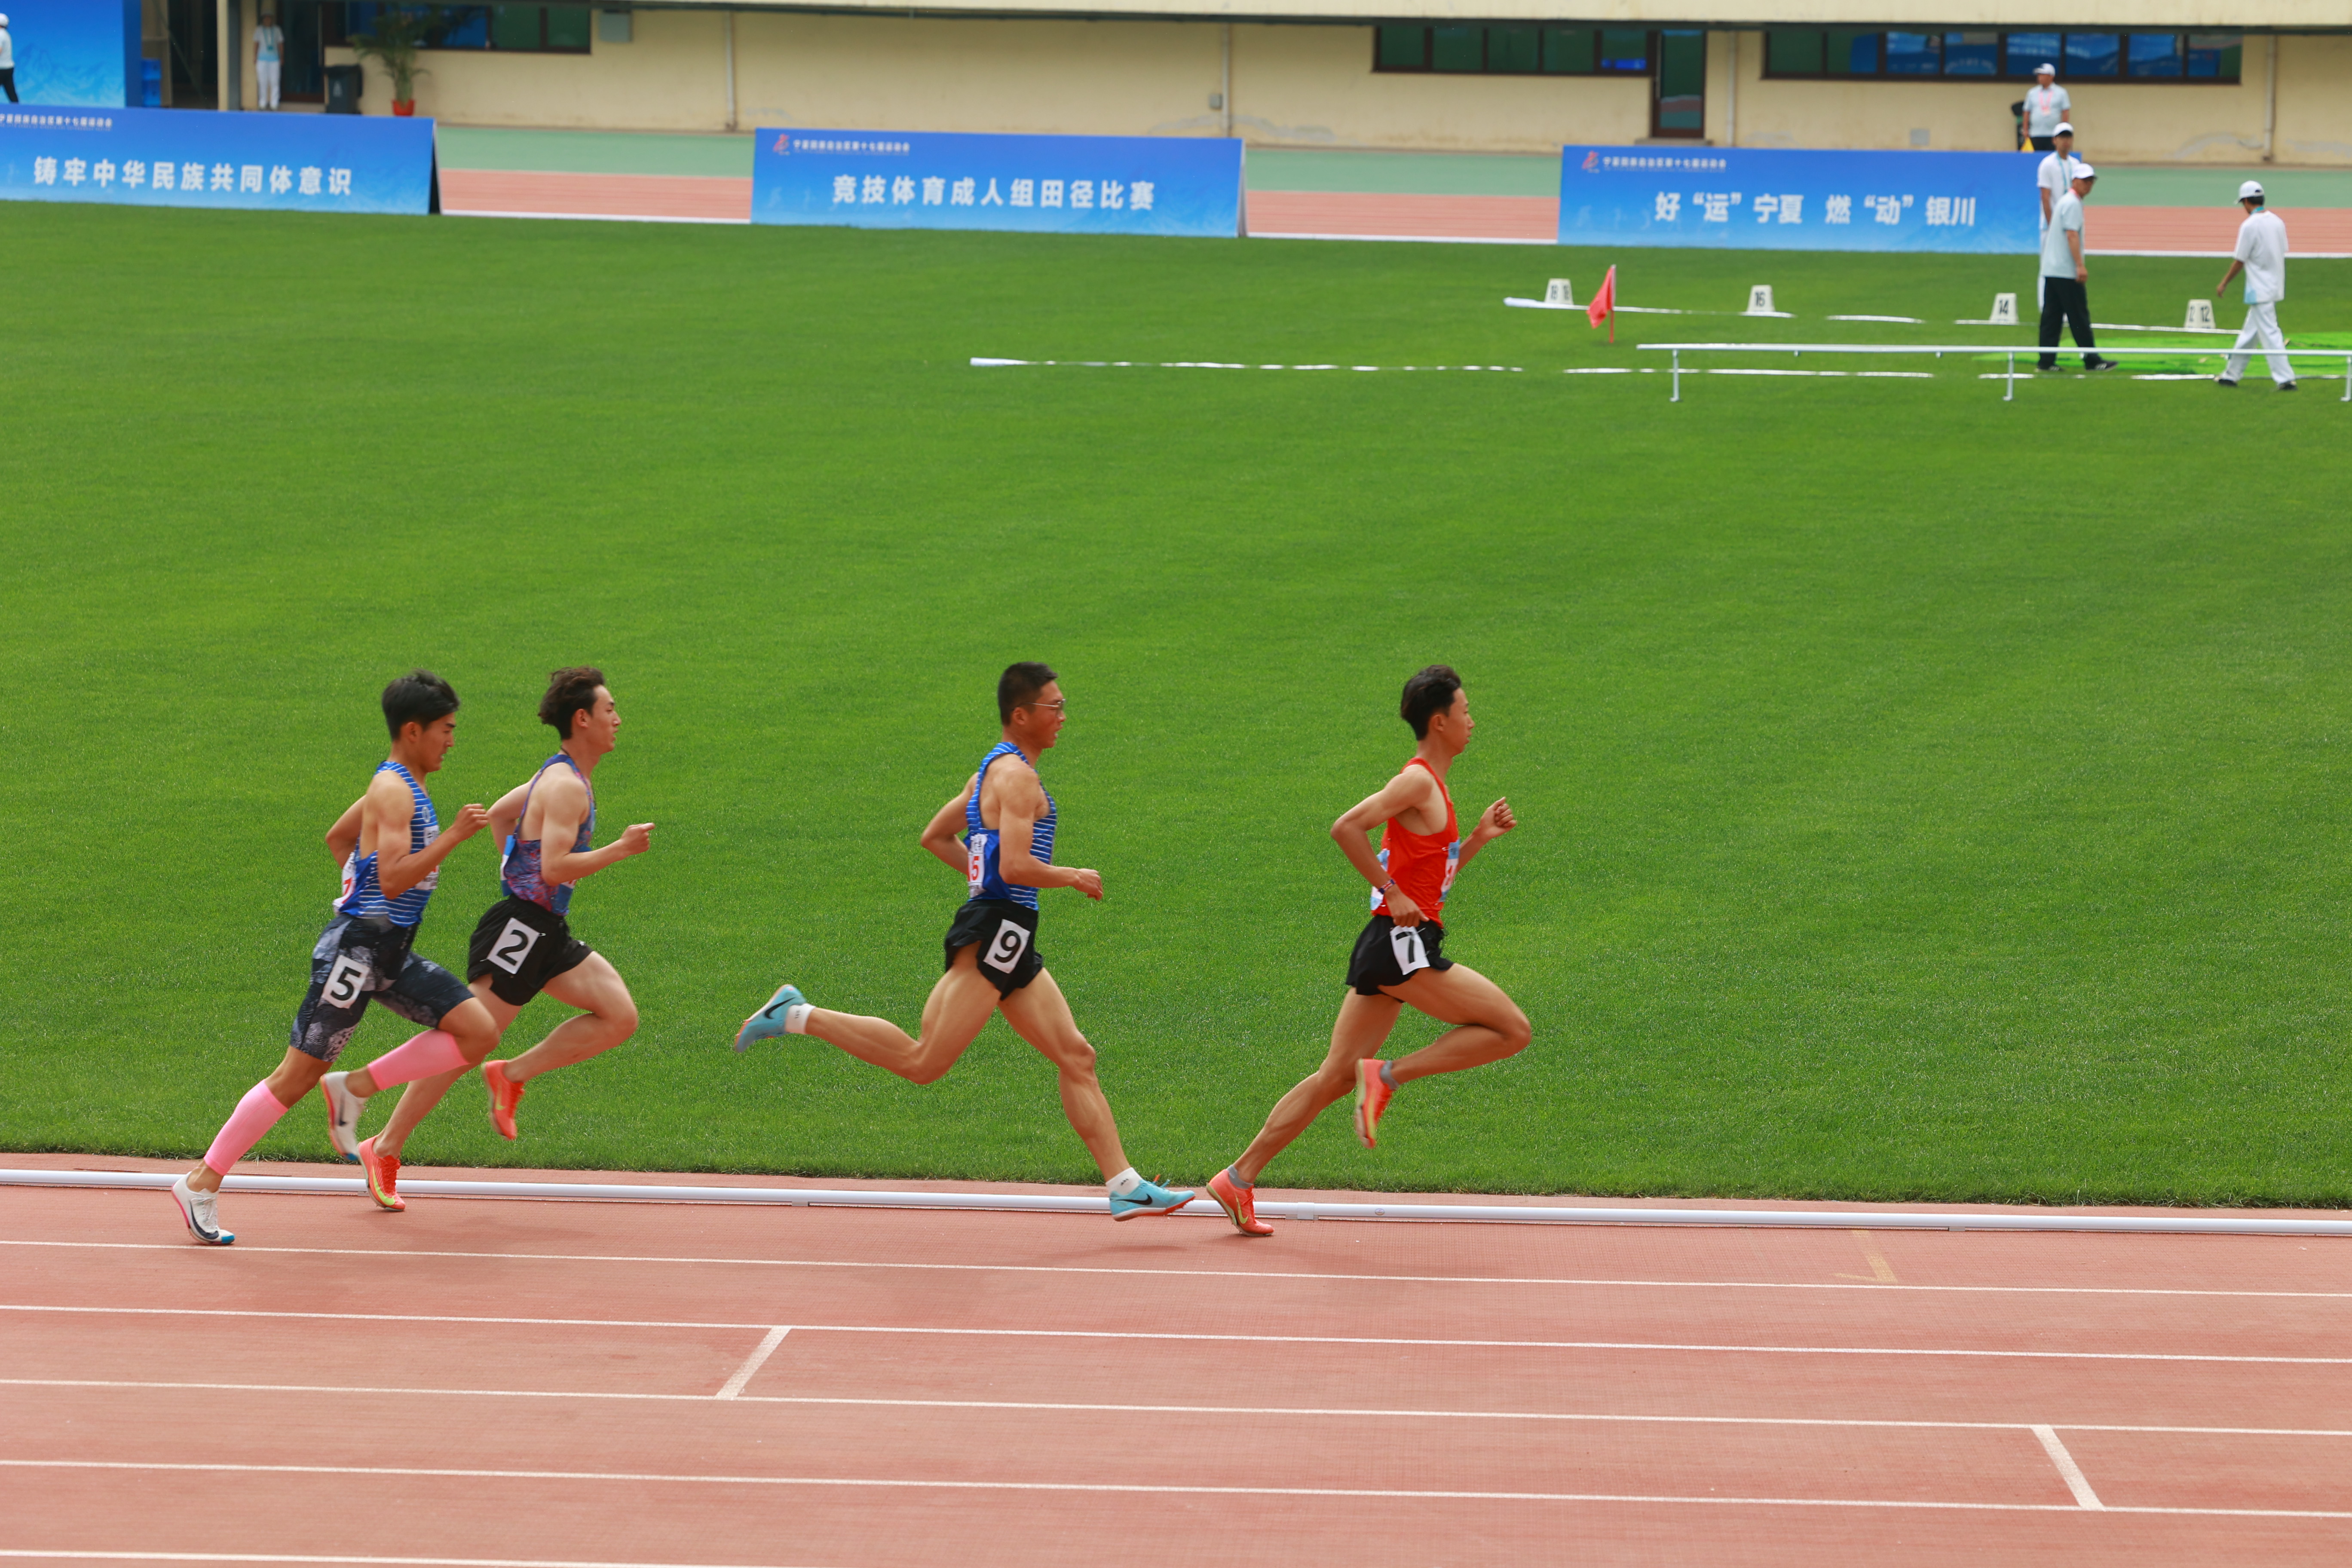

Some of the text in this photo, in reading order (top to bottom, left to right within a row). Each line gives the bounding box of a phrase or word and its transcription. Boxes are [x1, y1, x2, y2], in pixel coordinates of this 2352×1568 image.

[34, 156, 352, 196] 铸牢中华民族共同体意识
[832, 174, 1155, 210] 竞技体育成人组田径比赛
[1755, 291, 1765, 307] 16
[1999, 299, 2009, 315] 14
[2201, 306, 2210, 322] 12
[496, 929, 529, 966] 2
[993, 930, 1022, 964] 9
[1395, 931, 1415, 964] 7
[330, 966, 362, 1001] 5
